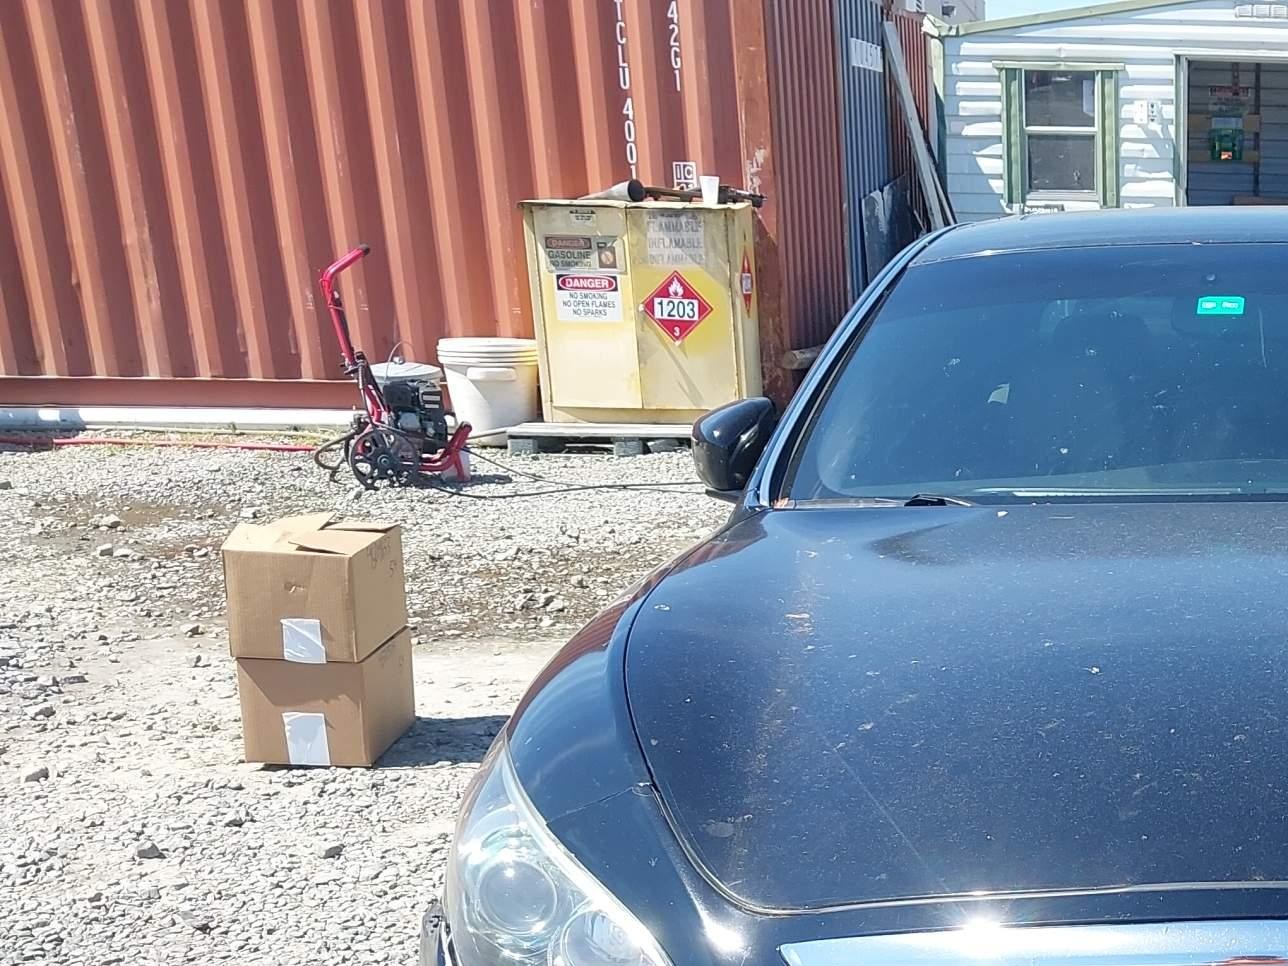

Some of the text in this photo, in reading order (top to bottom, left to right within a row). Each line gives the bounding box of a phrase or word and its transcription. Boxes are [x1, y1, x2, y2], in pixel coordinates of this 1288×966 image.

[667, 1, 681, 92] 42G1
[548, 250, 591, 260] GASOLINE
[565, 278, 609, 289] DANGER
[579, 292, 608, 300] SMOKING
[562, 300, 616, 309] NO OPEN FLAMES
[657, 299, 696, 319] 1203
[583, 309, 608, 317] SPARKS
[673, 326, 681, 337] 3
